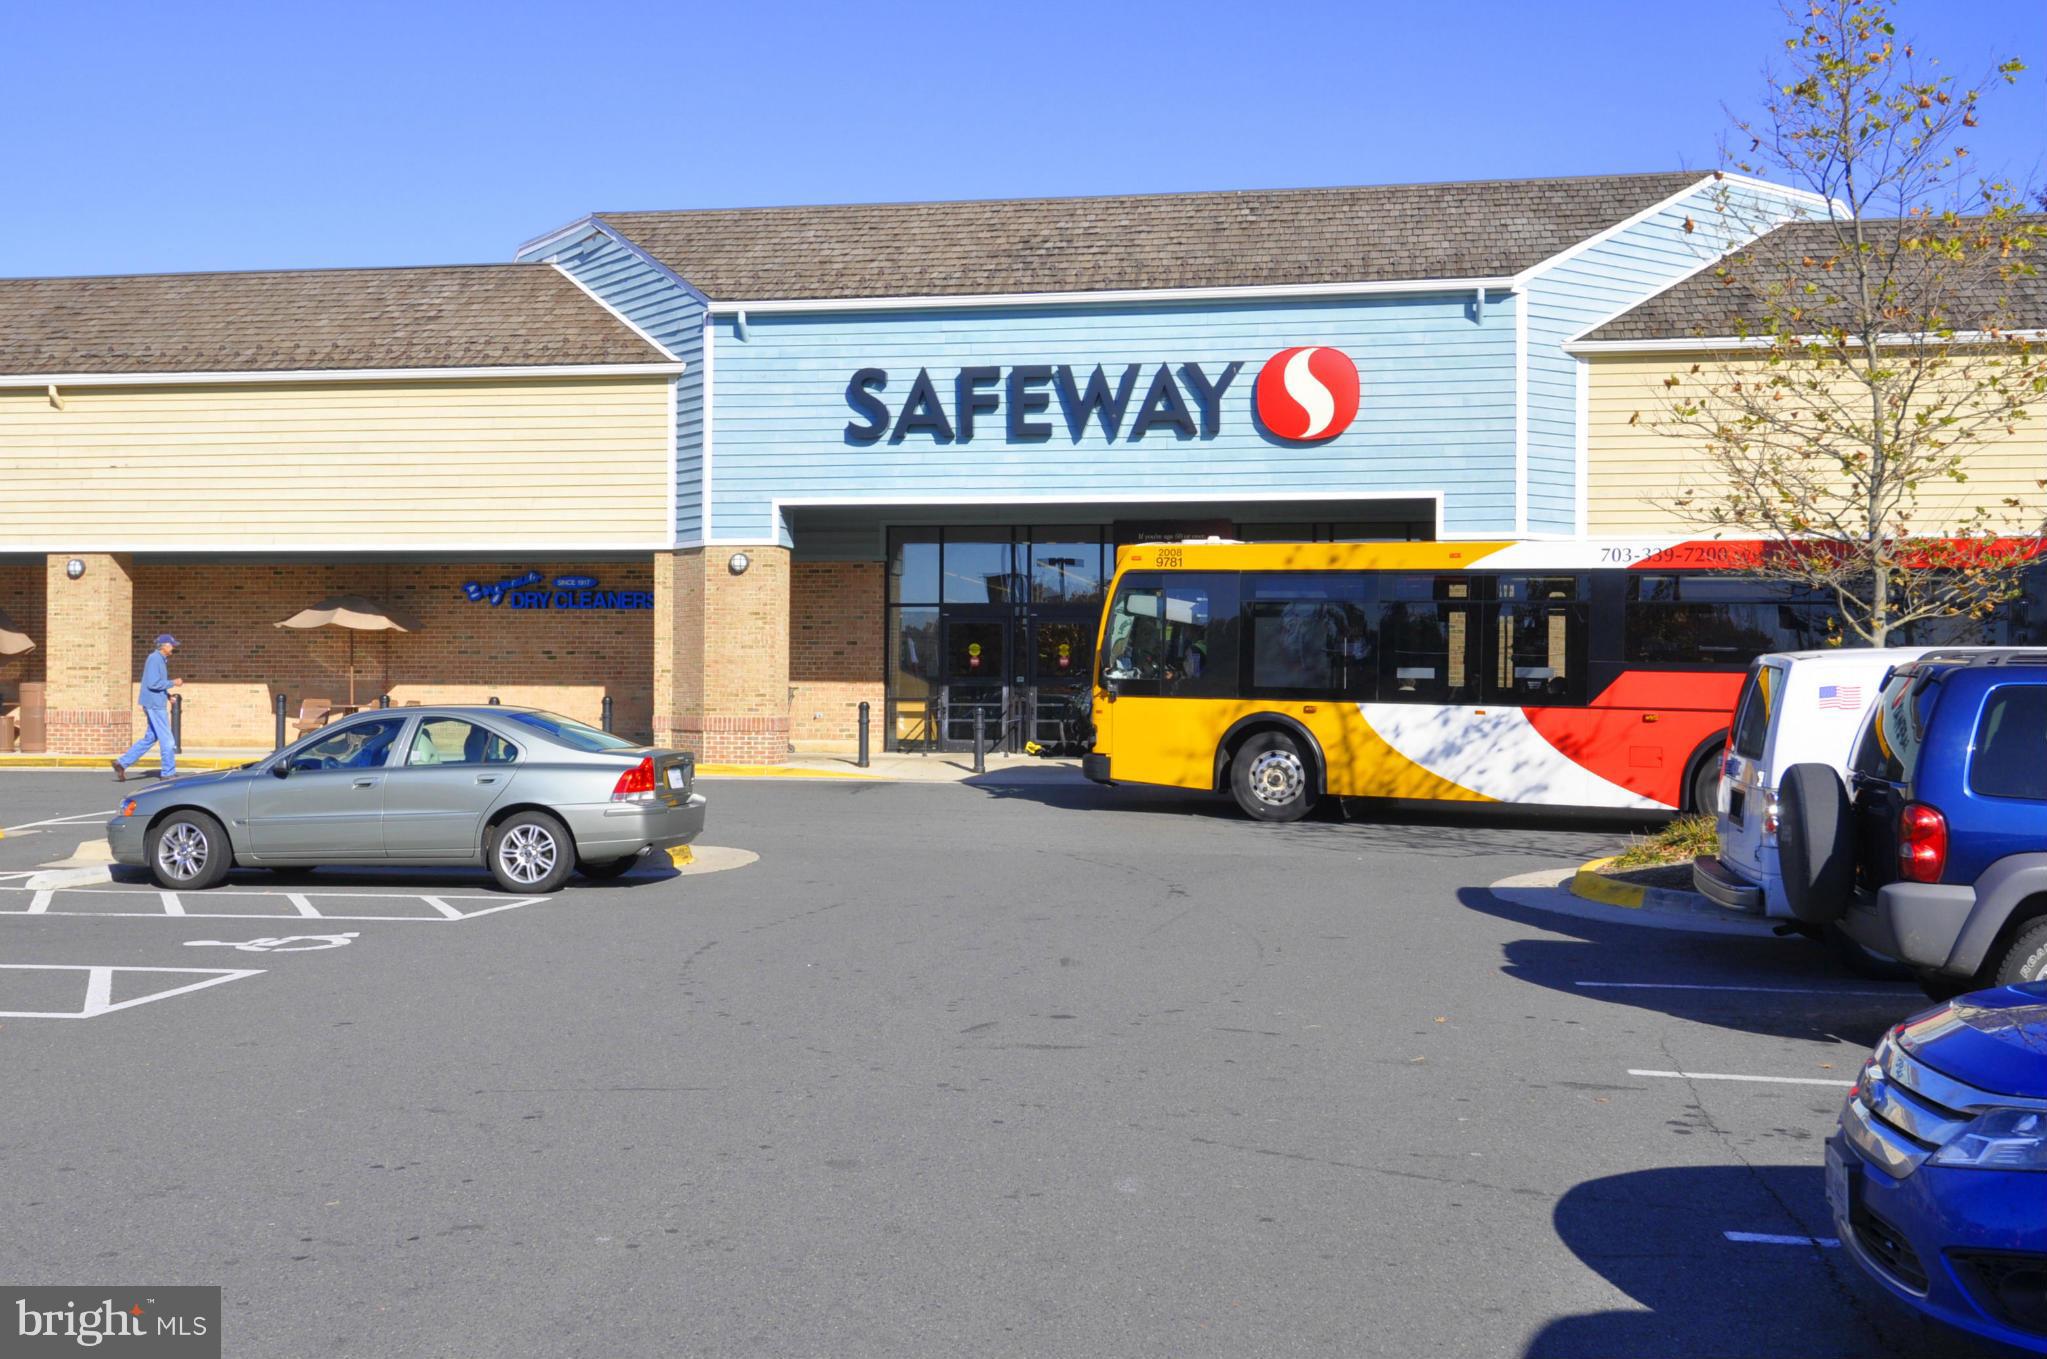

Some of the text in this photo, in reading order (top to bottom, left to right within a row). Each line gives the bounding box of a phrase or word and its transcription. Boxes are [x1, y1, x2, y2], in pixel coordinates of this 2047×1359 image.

[844, 361, 1245, 446] SAFEWAY
[1158, 548, 1183, 557] 2008
[1601, 547, 1729, 564] 703-339-7200
[1155, 557, 1184, 568] 9781
[511, 591, 551, 609] DRY
